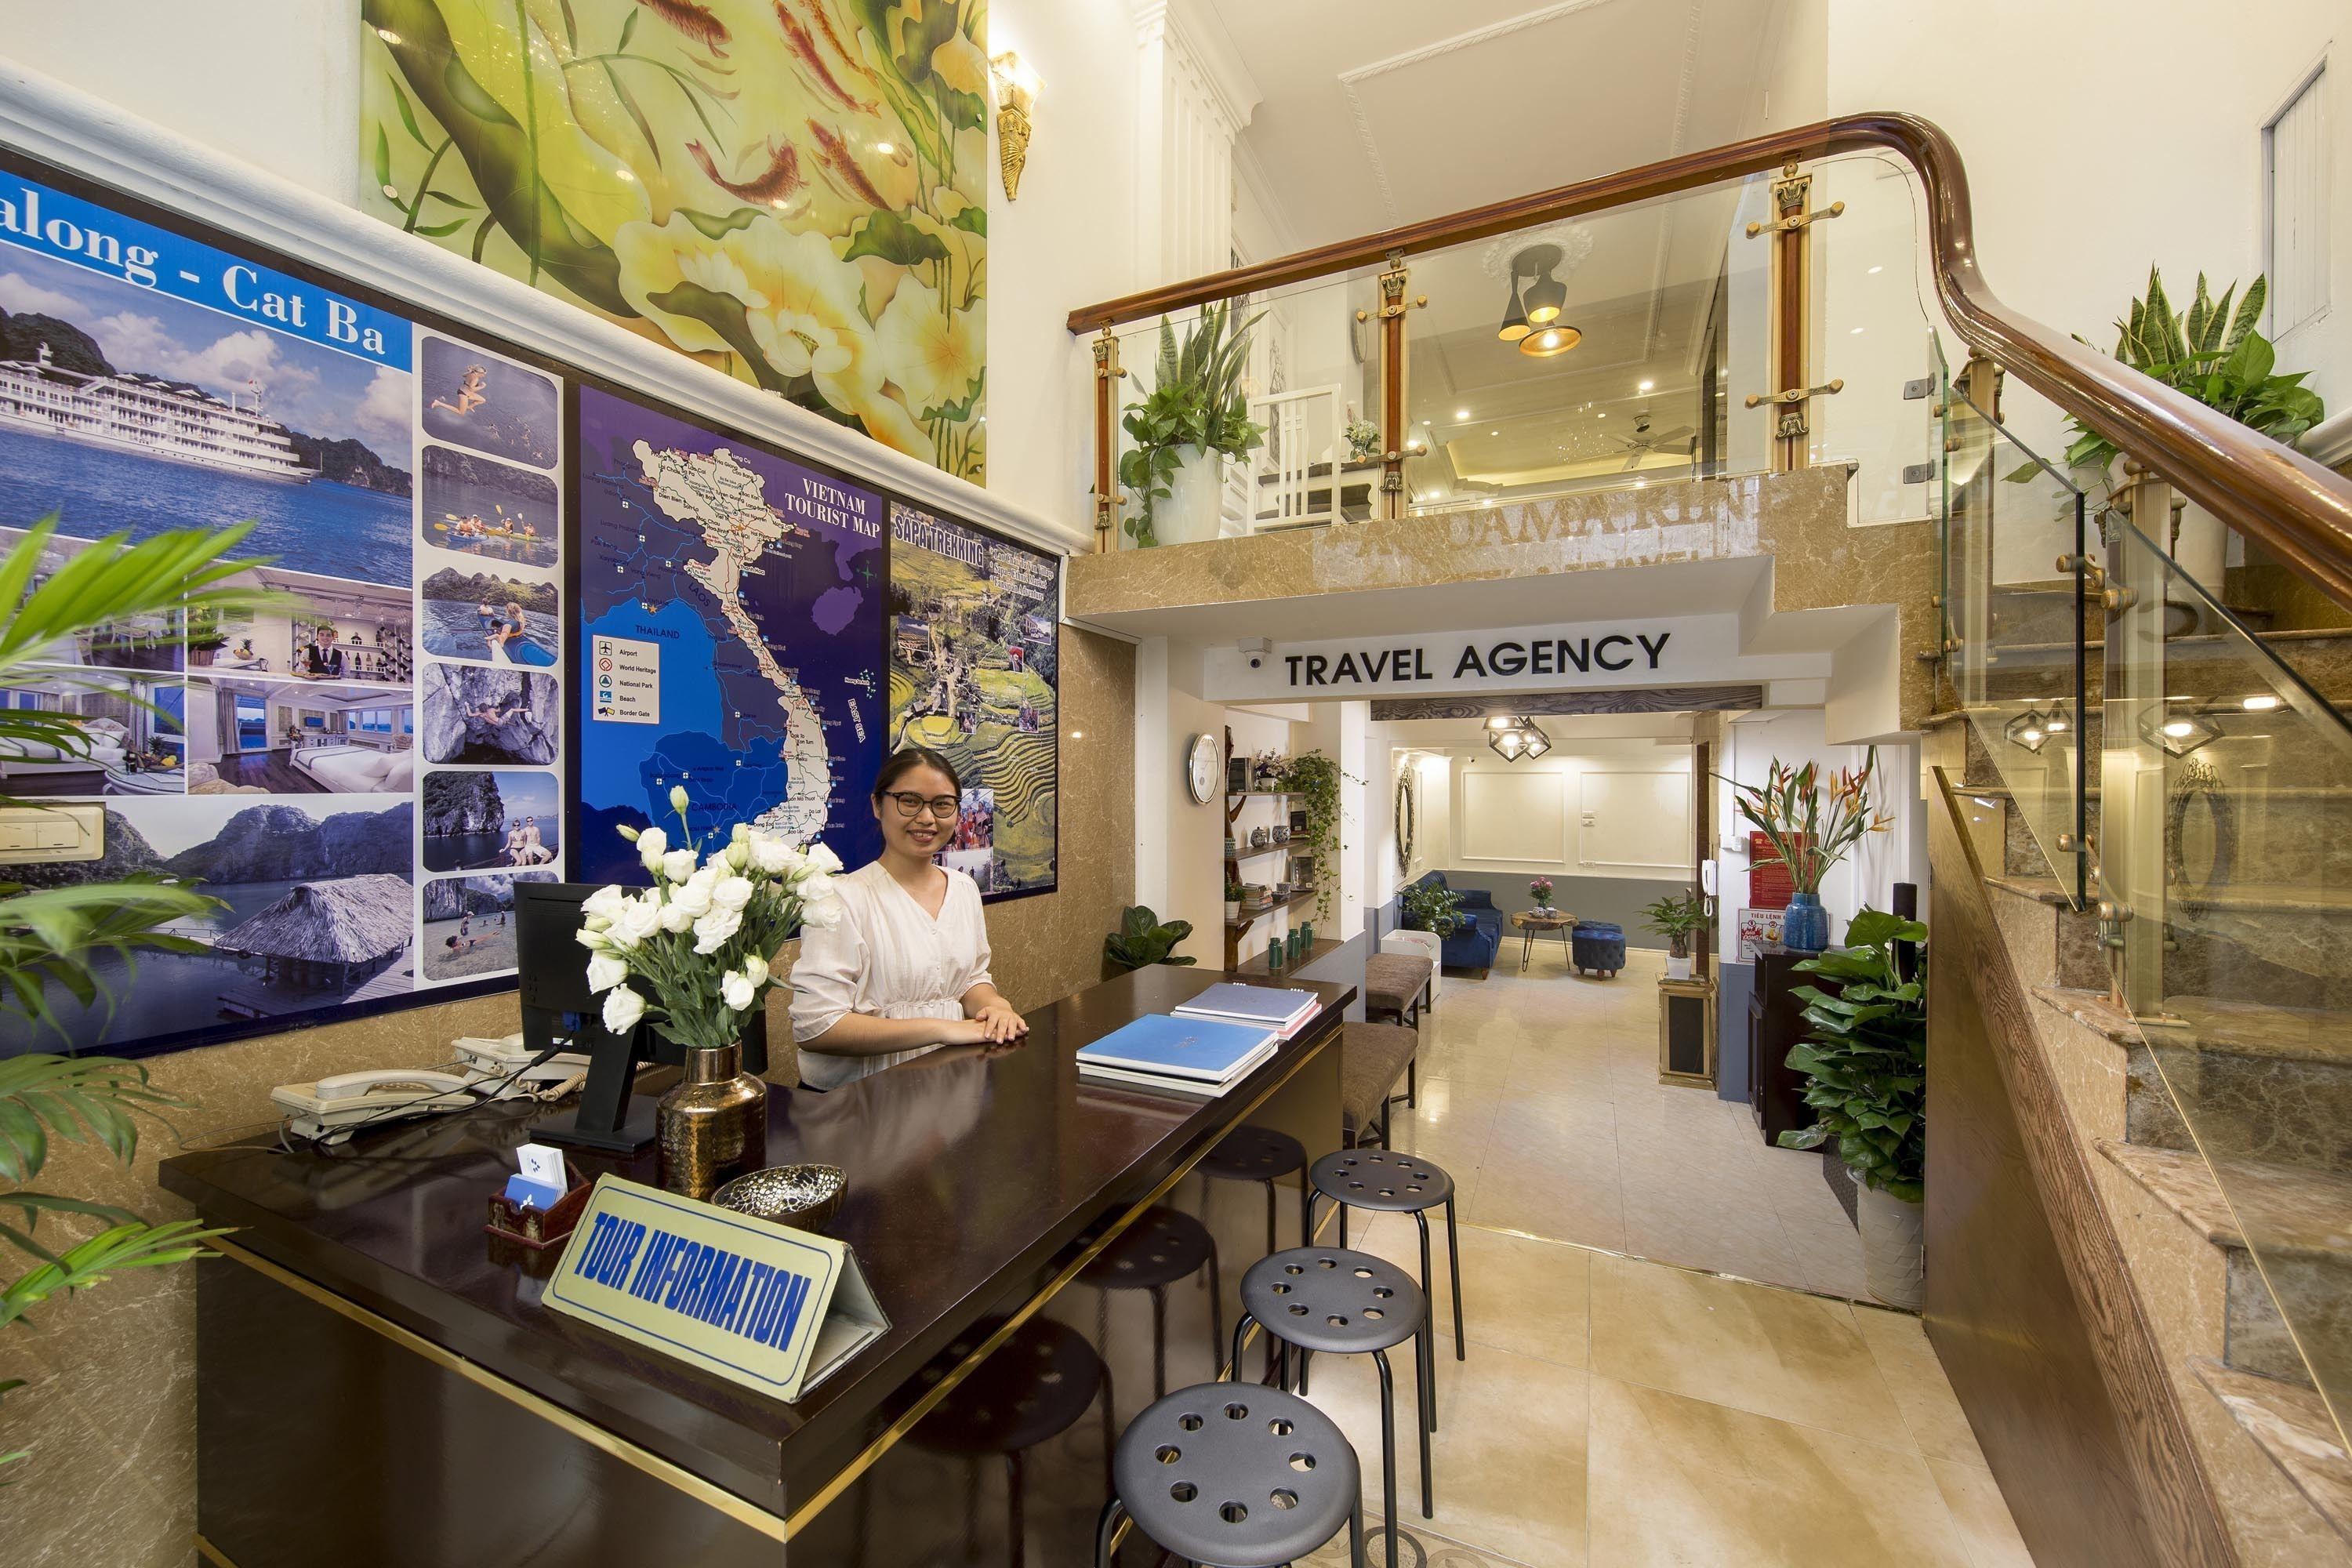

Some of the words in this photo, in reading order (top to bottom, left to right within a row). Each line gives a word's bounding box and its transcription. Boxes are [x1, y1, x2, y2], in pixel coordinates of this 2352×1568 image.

[180, 270, 200, 284] -
[223, 265, 307, 328] Cat
[326, 298, 386, 355] Ba
[785, 492, 849, 528] TOURIST
[852, 516, 880, 539] MAP
[802, 477, 866, 516] VIETNAM
[895, 514, 928, 549] SAPA
[930, 526, 984, 568] TREKKING
[688, 583, 710, 607] LAOS
[994, 563, 1007, 578] Sapa
[1029, 574, 1047, 590] Market
[635, 625, 680, 639] THAILAND
[636, 666, 656, 674] Heritage
[1285, 648, 1432, 686] TRAVEL
[1453, 633, 1671, 679] AGENCY
[848, 698, 861, 724] EAST
[855, 723, 866, 743] SEA
[691, 803, 737, 812] CAMBODIA
[574, 1210, 647, 1291] TOUR
[628, 1229, 812, 1352] INFORMATION
